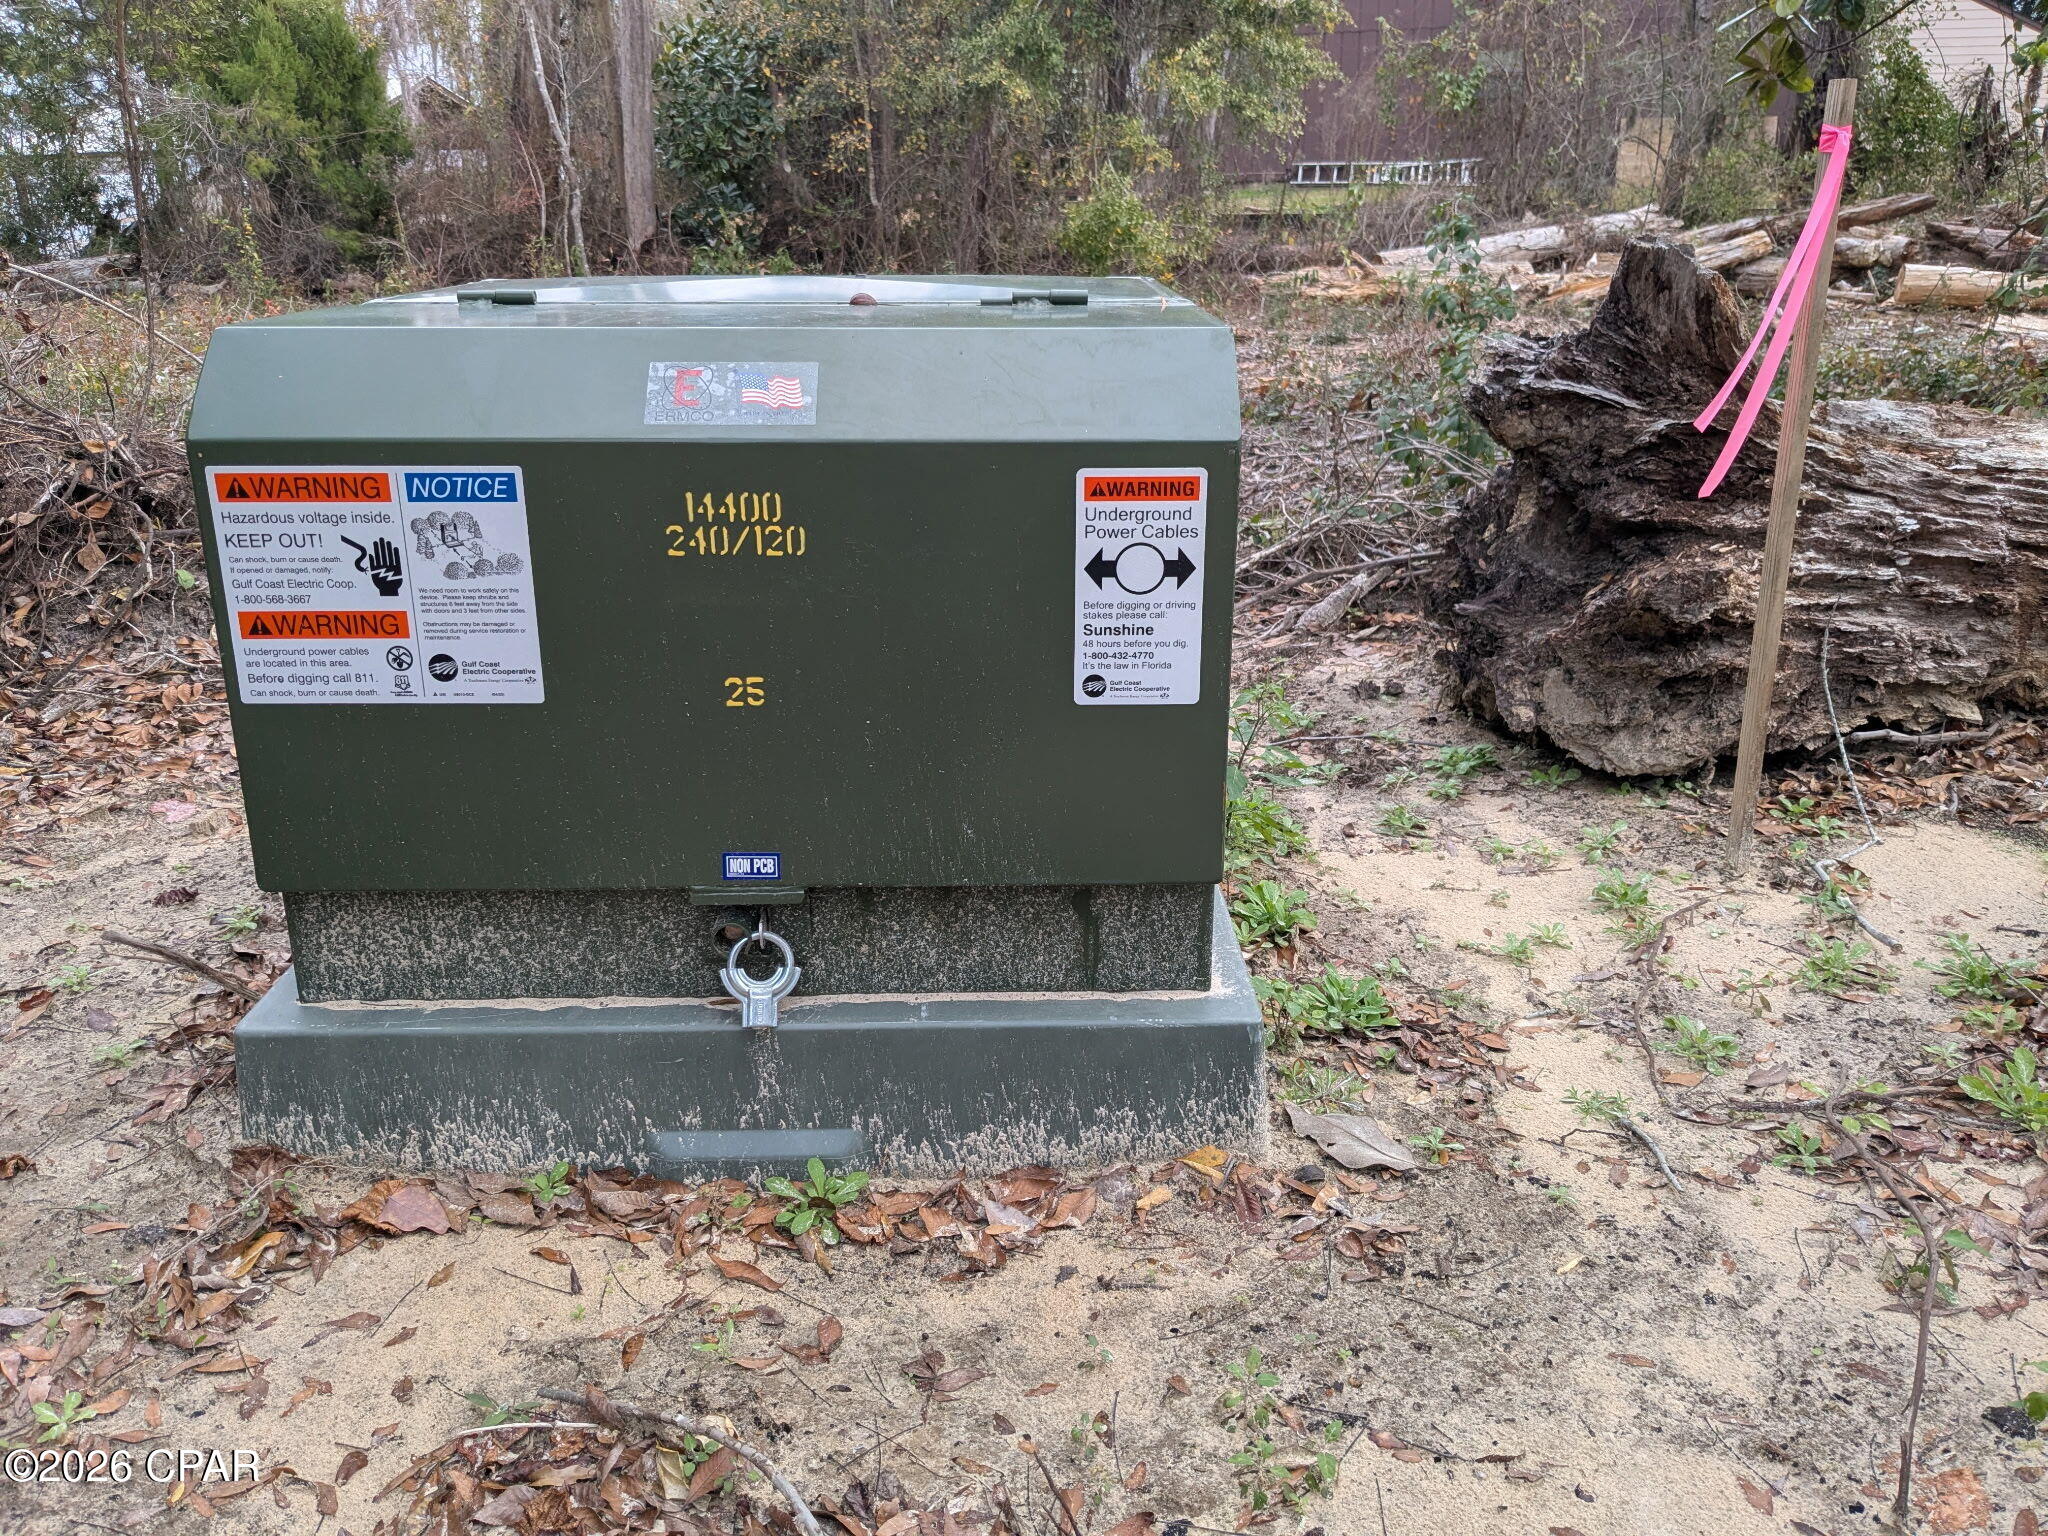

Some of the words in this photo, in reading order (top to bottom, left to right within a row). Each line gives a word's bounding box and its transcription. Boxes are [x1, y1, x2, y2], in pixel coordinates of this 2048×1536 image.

[654, 410, 714, 422] ERMCO
[249, 477, 381, 499] WARNING
[412, 477, 508, 498] NOTICE
[1106, 481, 1195, 497] WARNING
[685, 492, 782, 522] 14400
[221, 512, 294, 524] Hazardous
[298, 512, 347, 526] voltage
[351, 512, 395, 524] inside.
[1085, 507, 1192, 524] Underground
[1085, 525, 1136, 538] Power
[1142, 525, 1199, 538] Cables
[224, 534, 272, 548] KEEP
[279, 534, 323, 548] OUT!
[666, 525, 806, 556] 240/120
[232, 579, 252, 589] Gulf
[255, 579, 285, 589] Coast
[288, 579, 324, 589] Electric
[327, 579, 357, 590] Coop.
[235, 595, 311, 604] 1-800-568-3667
[1084, 601, 1114, 610] Before
[1117, 601, 1150, 611] digging
[1166, 601, 1196, 610] driving
[1083, 611, 1113, 619] stakes
[1116, 611, 1146, 620] please
[1150, 611, 1168, 619] call:
[271, 614, 400, 635] WARNING
[1084, 624, 1154, 636] Sunshine
[1173, 640, 1188, 649] dig.
[244, 648, 306, 657] Underground
[248, 674, 284, 683] Before
[288, 674, 329, 685] digging
[333, 674, 351, 683] call
[355, 674, 378, 683] 811.
[396, 676, 408, 684] 811
[724, 676, 764, 707] 25
[729, 858, 750, 874] NON
[754, 858, 774, 874] PCB
